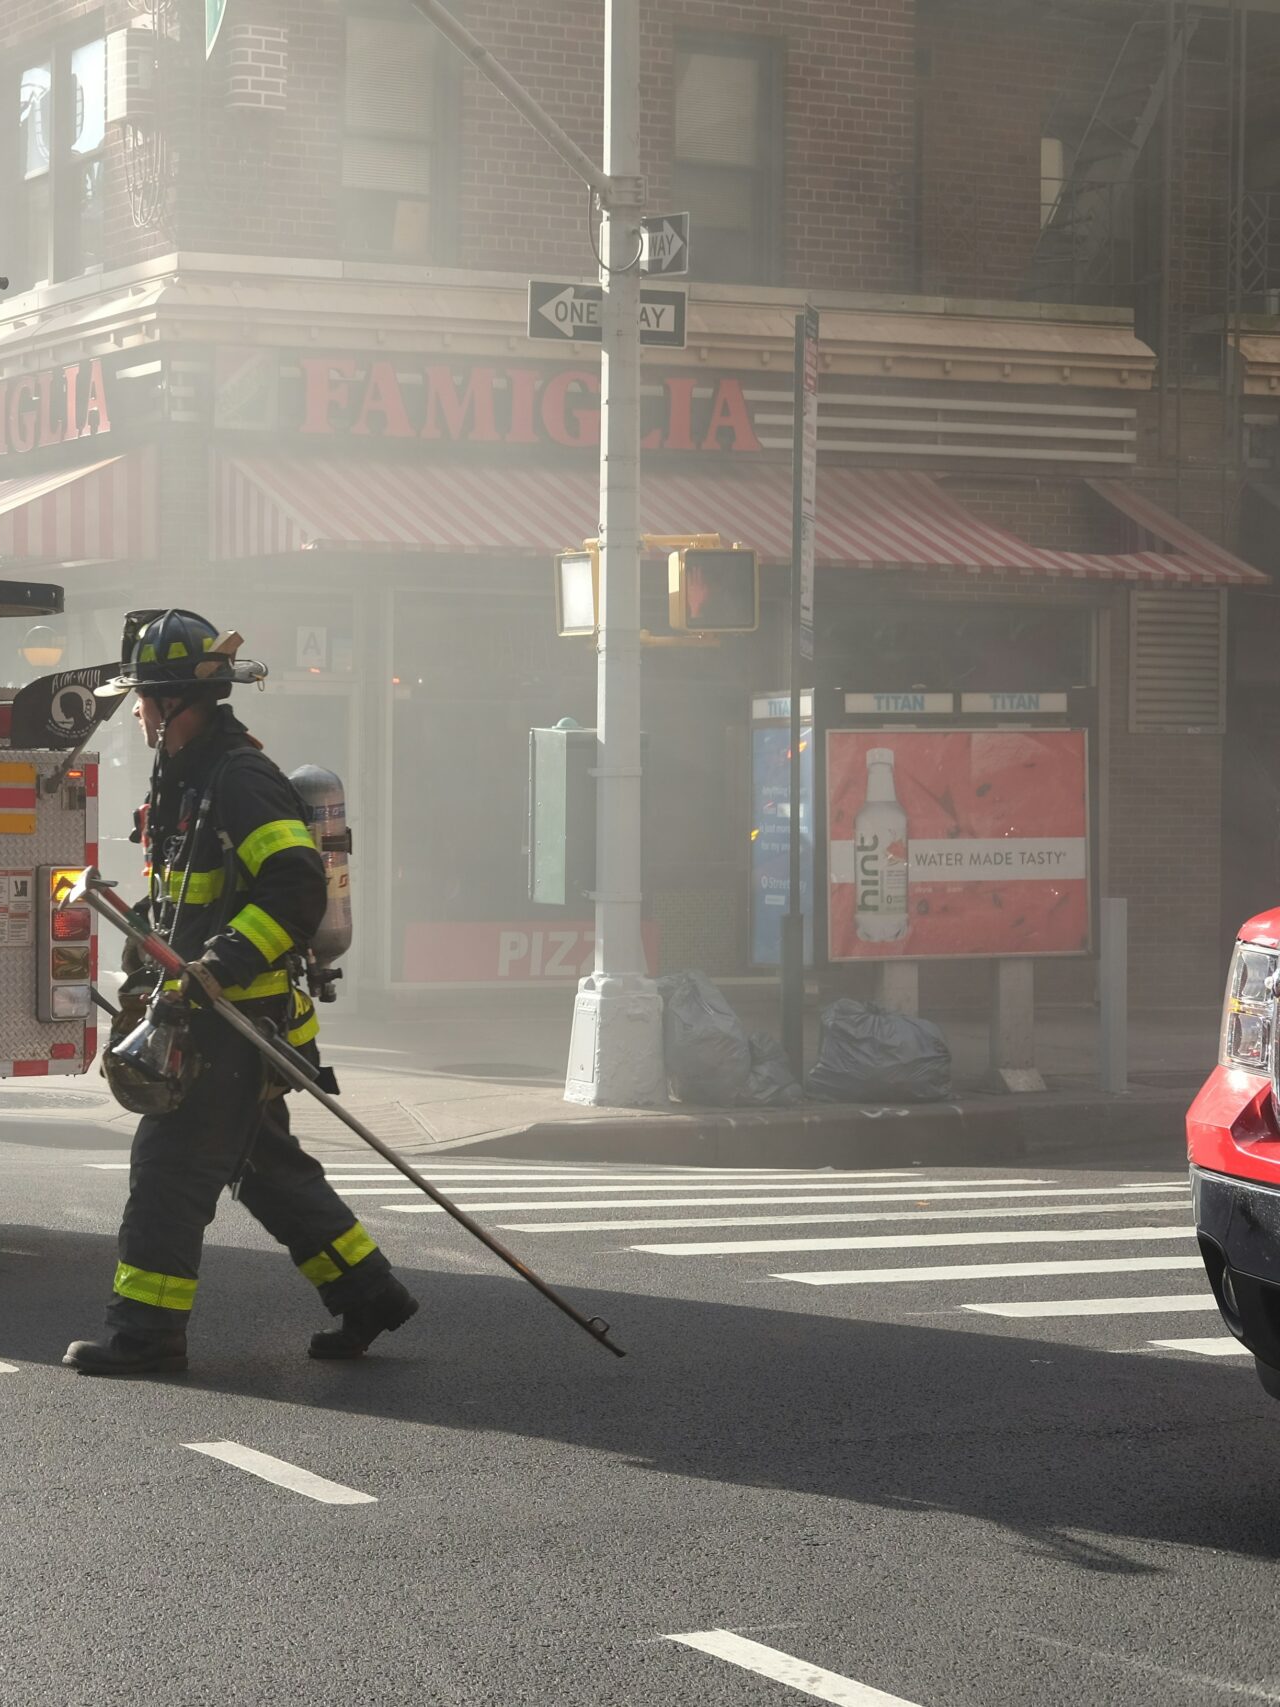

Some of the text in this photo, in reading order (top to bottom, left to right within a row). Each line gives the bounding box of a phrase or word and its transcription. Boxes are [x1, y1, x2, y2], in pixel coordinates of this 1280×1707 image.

[554, 300, 666, 329] ONE AY
[297, 356, 762, 452] FAMIGIA
[302, 631, 322, 656] A
[767, 700, 792, 717] TITA
[873, 694, 925, 711] TITAN
[989, 693, 1040, 710] TITAN
[915, 853, 963, 866] WATER
[969, 852, 1014, 866] MADE
[856, 832, 880, 912] hint
